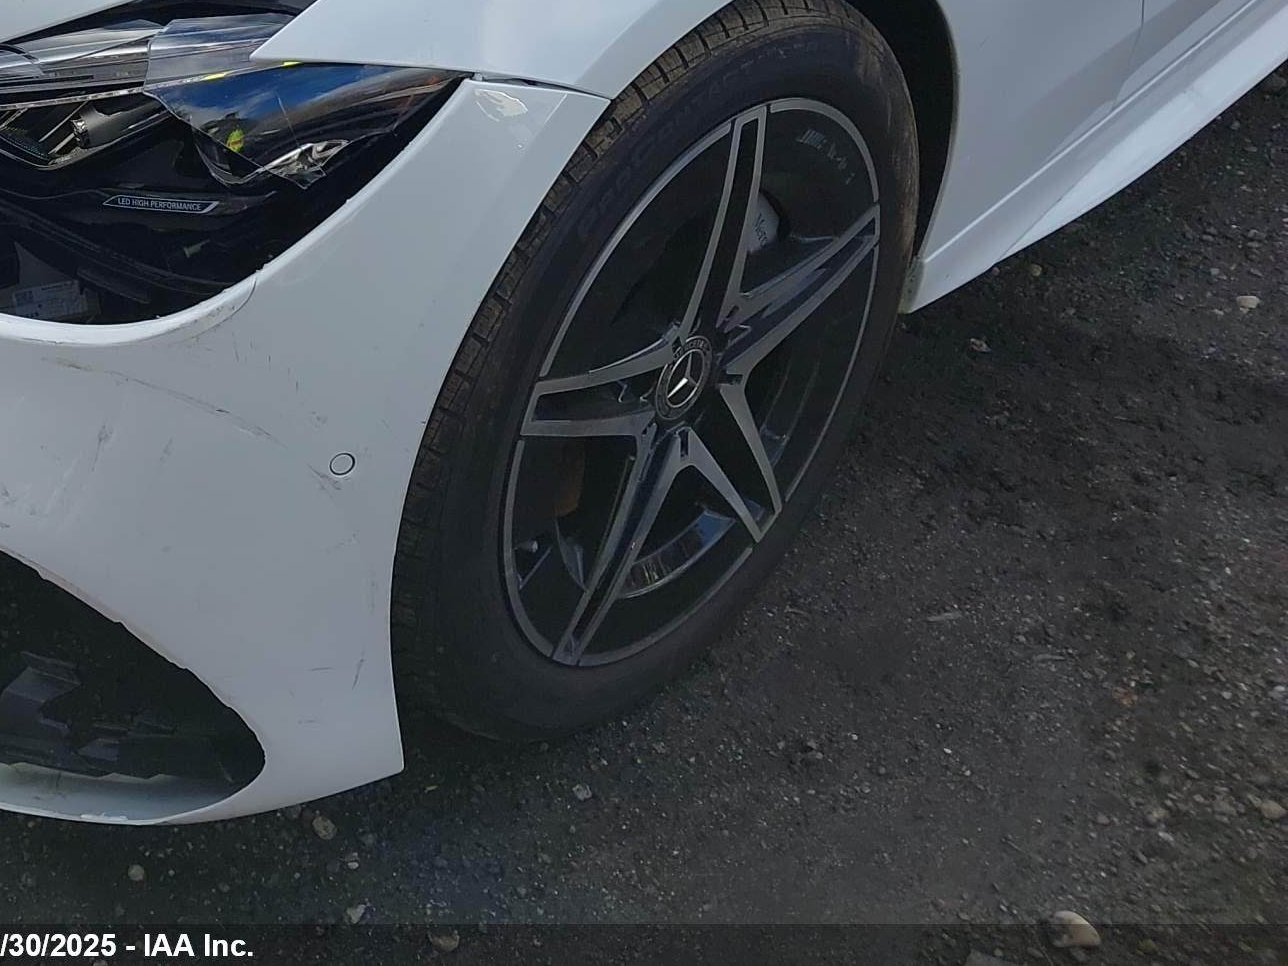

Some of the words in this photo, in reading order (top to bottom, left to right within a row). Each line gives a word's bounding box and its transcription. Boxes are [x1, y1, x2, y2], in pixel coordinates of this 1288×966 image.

[117, 197, 131, 206] LED
[132, 198, 149, 207] HIGH
[150, 200, 202, 211] PERFORMANCE
